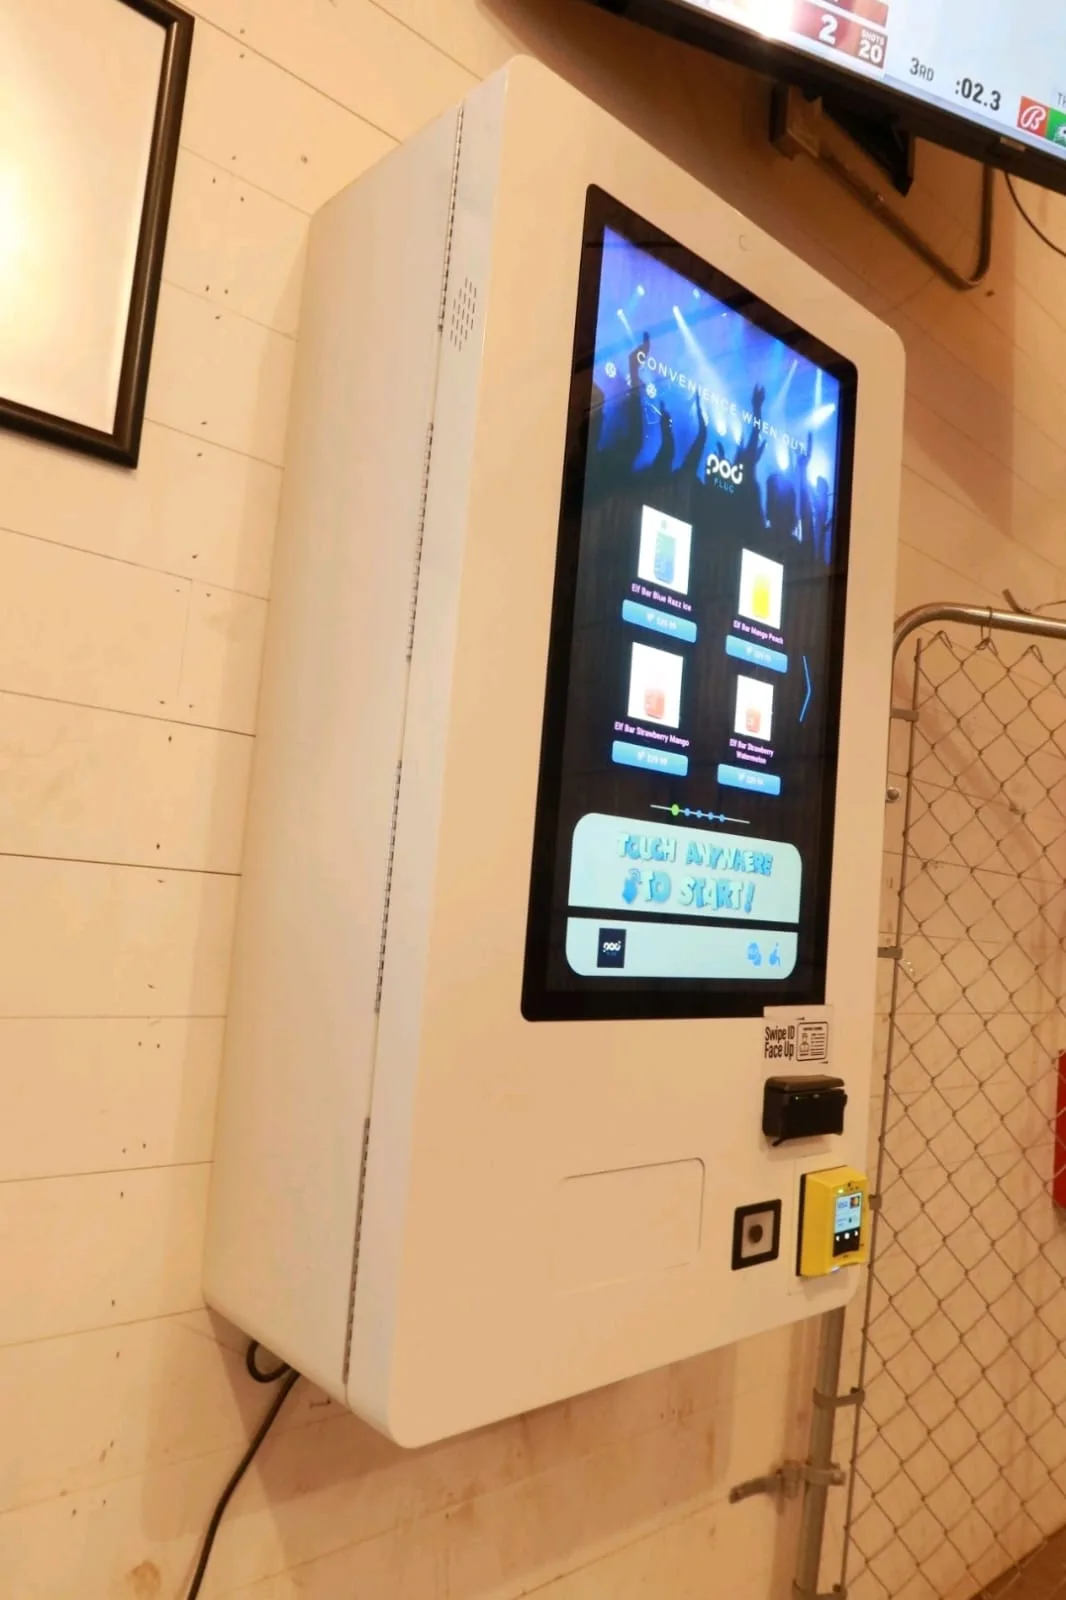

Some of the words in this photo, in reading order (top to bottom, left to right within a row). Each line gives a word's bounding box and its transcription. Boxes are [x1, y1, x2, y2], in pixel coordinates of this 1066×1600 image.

[818, 13, 839, 45] 2
[858, 39, 883, 64] 20
[909, 57, 935, 82] 3RD
[954, 77, 1002, 111] :02.3
[636, 350, 737, 416] CONVENIENCE
[742, 409, 778, 438] WHEN
[631, 582, 641, 594] Elf
[641, 586, 652, 598] Bar
[652, 590, 667, 603] Blue
[614, 721, 624, 731] Elf
[624, 723, 635, 735] Bar
[636, 726, 669, 744] Strawberry
[669, 734, 690, 748] Mango
[616, 831, 678, 863] TOUCH
[685, 839, 774, 877] ANYWHERE
[641, 867, 672, 903] TO
[677, 875, 756, 914] START!
[765, 1025, 787, 1043] Swipe
[787, 1025, 795, 1040] ID
[764, 1041, 783, 1059] Face
[784, 1040, 795, 1060] Up
